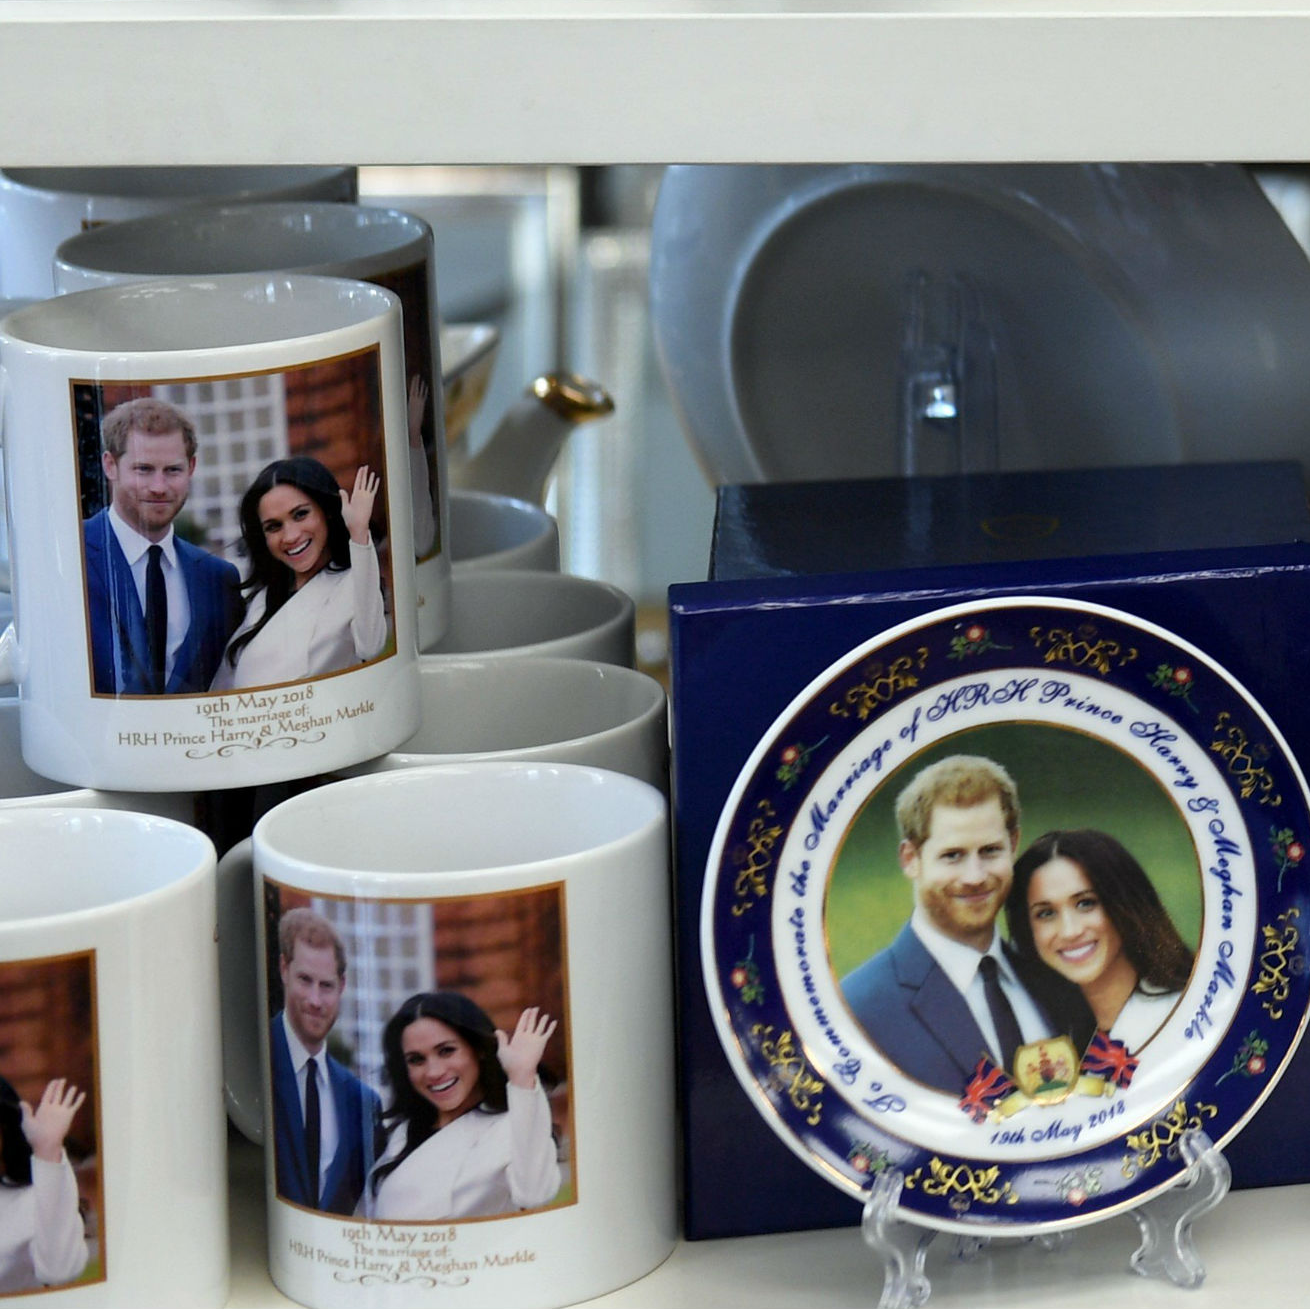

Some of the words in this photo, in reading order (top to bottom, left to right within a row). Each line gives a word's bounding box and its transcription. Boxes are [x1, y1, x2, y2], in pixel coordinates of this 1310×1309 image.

[196, 698, 230, 717] 19th
[236, 694, 278, 714] May
[282, 685, 314, 704] 2018
[208, 715, 234, 728] The
[237, 711, 292, 726] marriage
[898, 706, 922, 740] of
[926, 678, 1034, 723] HRH
[1037, 679, 1124, 725] Prince
[117, 732, 158, 747] HRH
[163, 733, 206, 746] Prince
[211, 728, 255, 744] Harry
[259, 724, 273, 737] &
[277, 715, 333, 733] Meghan
[335, 700, 375, 721] Markle
[1128, 721, 1200, 790] Harry
[803, 738, 893, 852] Marriage
[1186, 796, 1220, 815] &
[788, 859, 812, 898] the
[1207, 818, 1244, 932] Meghan
[793, 907, 862, 1086] Commemorate
[1183, 939, 1236, 1040] Markle
[861, 1081, 907, 1113] To
[990, 1127, 1025, 1145] 19th
[1031, 1118, 1083, 1142] May
